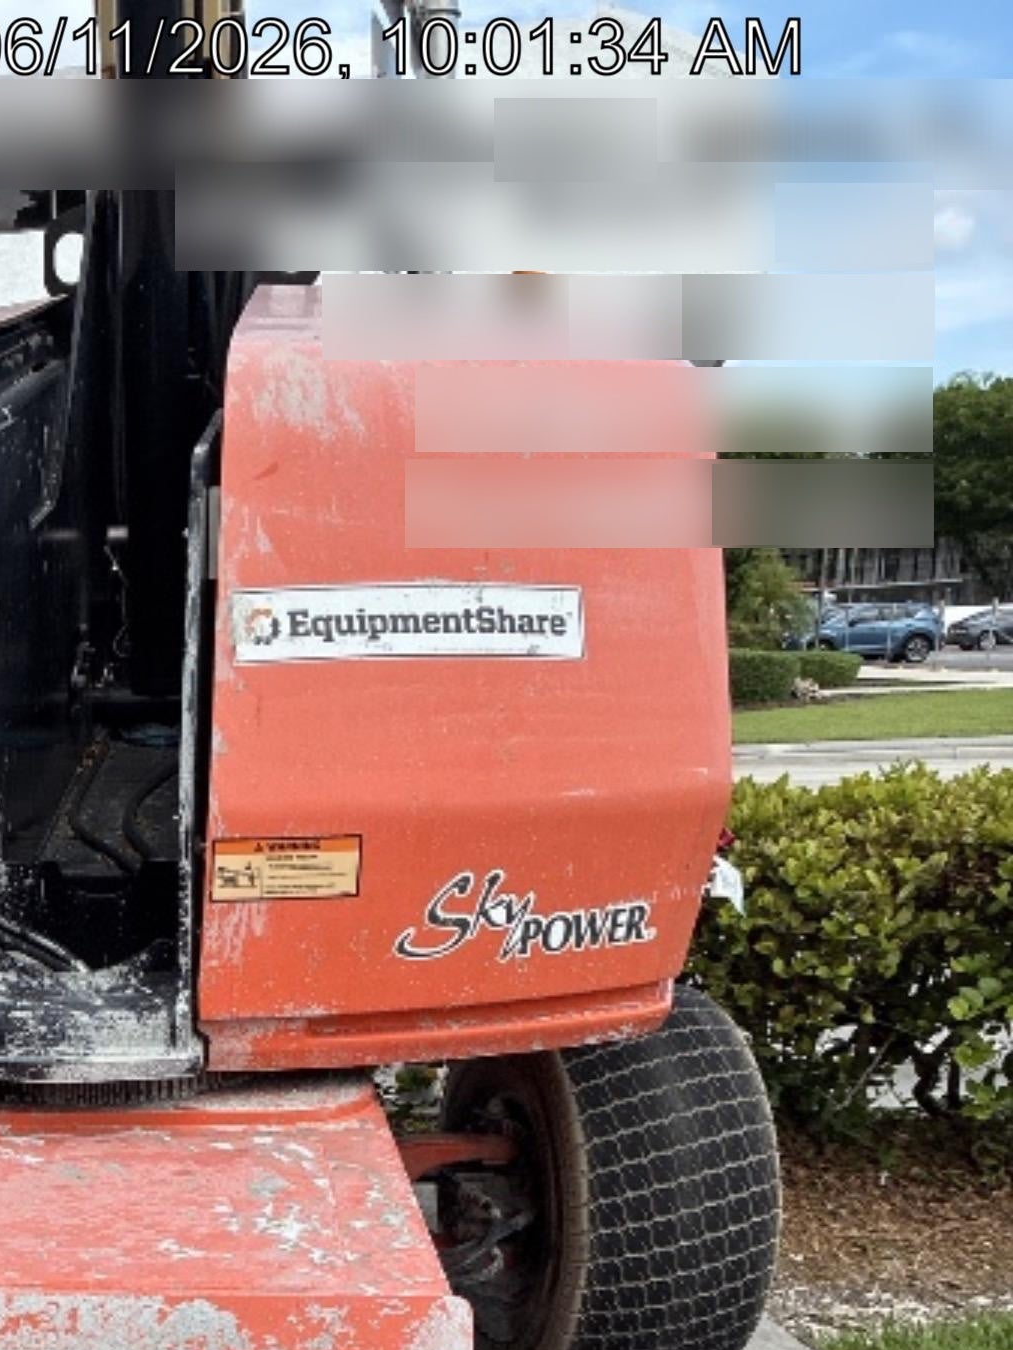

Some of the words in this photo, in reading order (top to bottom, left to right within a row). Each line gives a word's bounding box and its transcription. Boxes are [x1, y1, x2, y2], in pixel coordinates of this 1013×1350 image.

[287, 606, 567, 642] EquipmentShare
[393, 870, 535, 961] Sky
[515, 900, 650, 956] POWER
